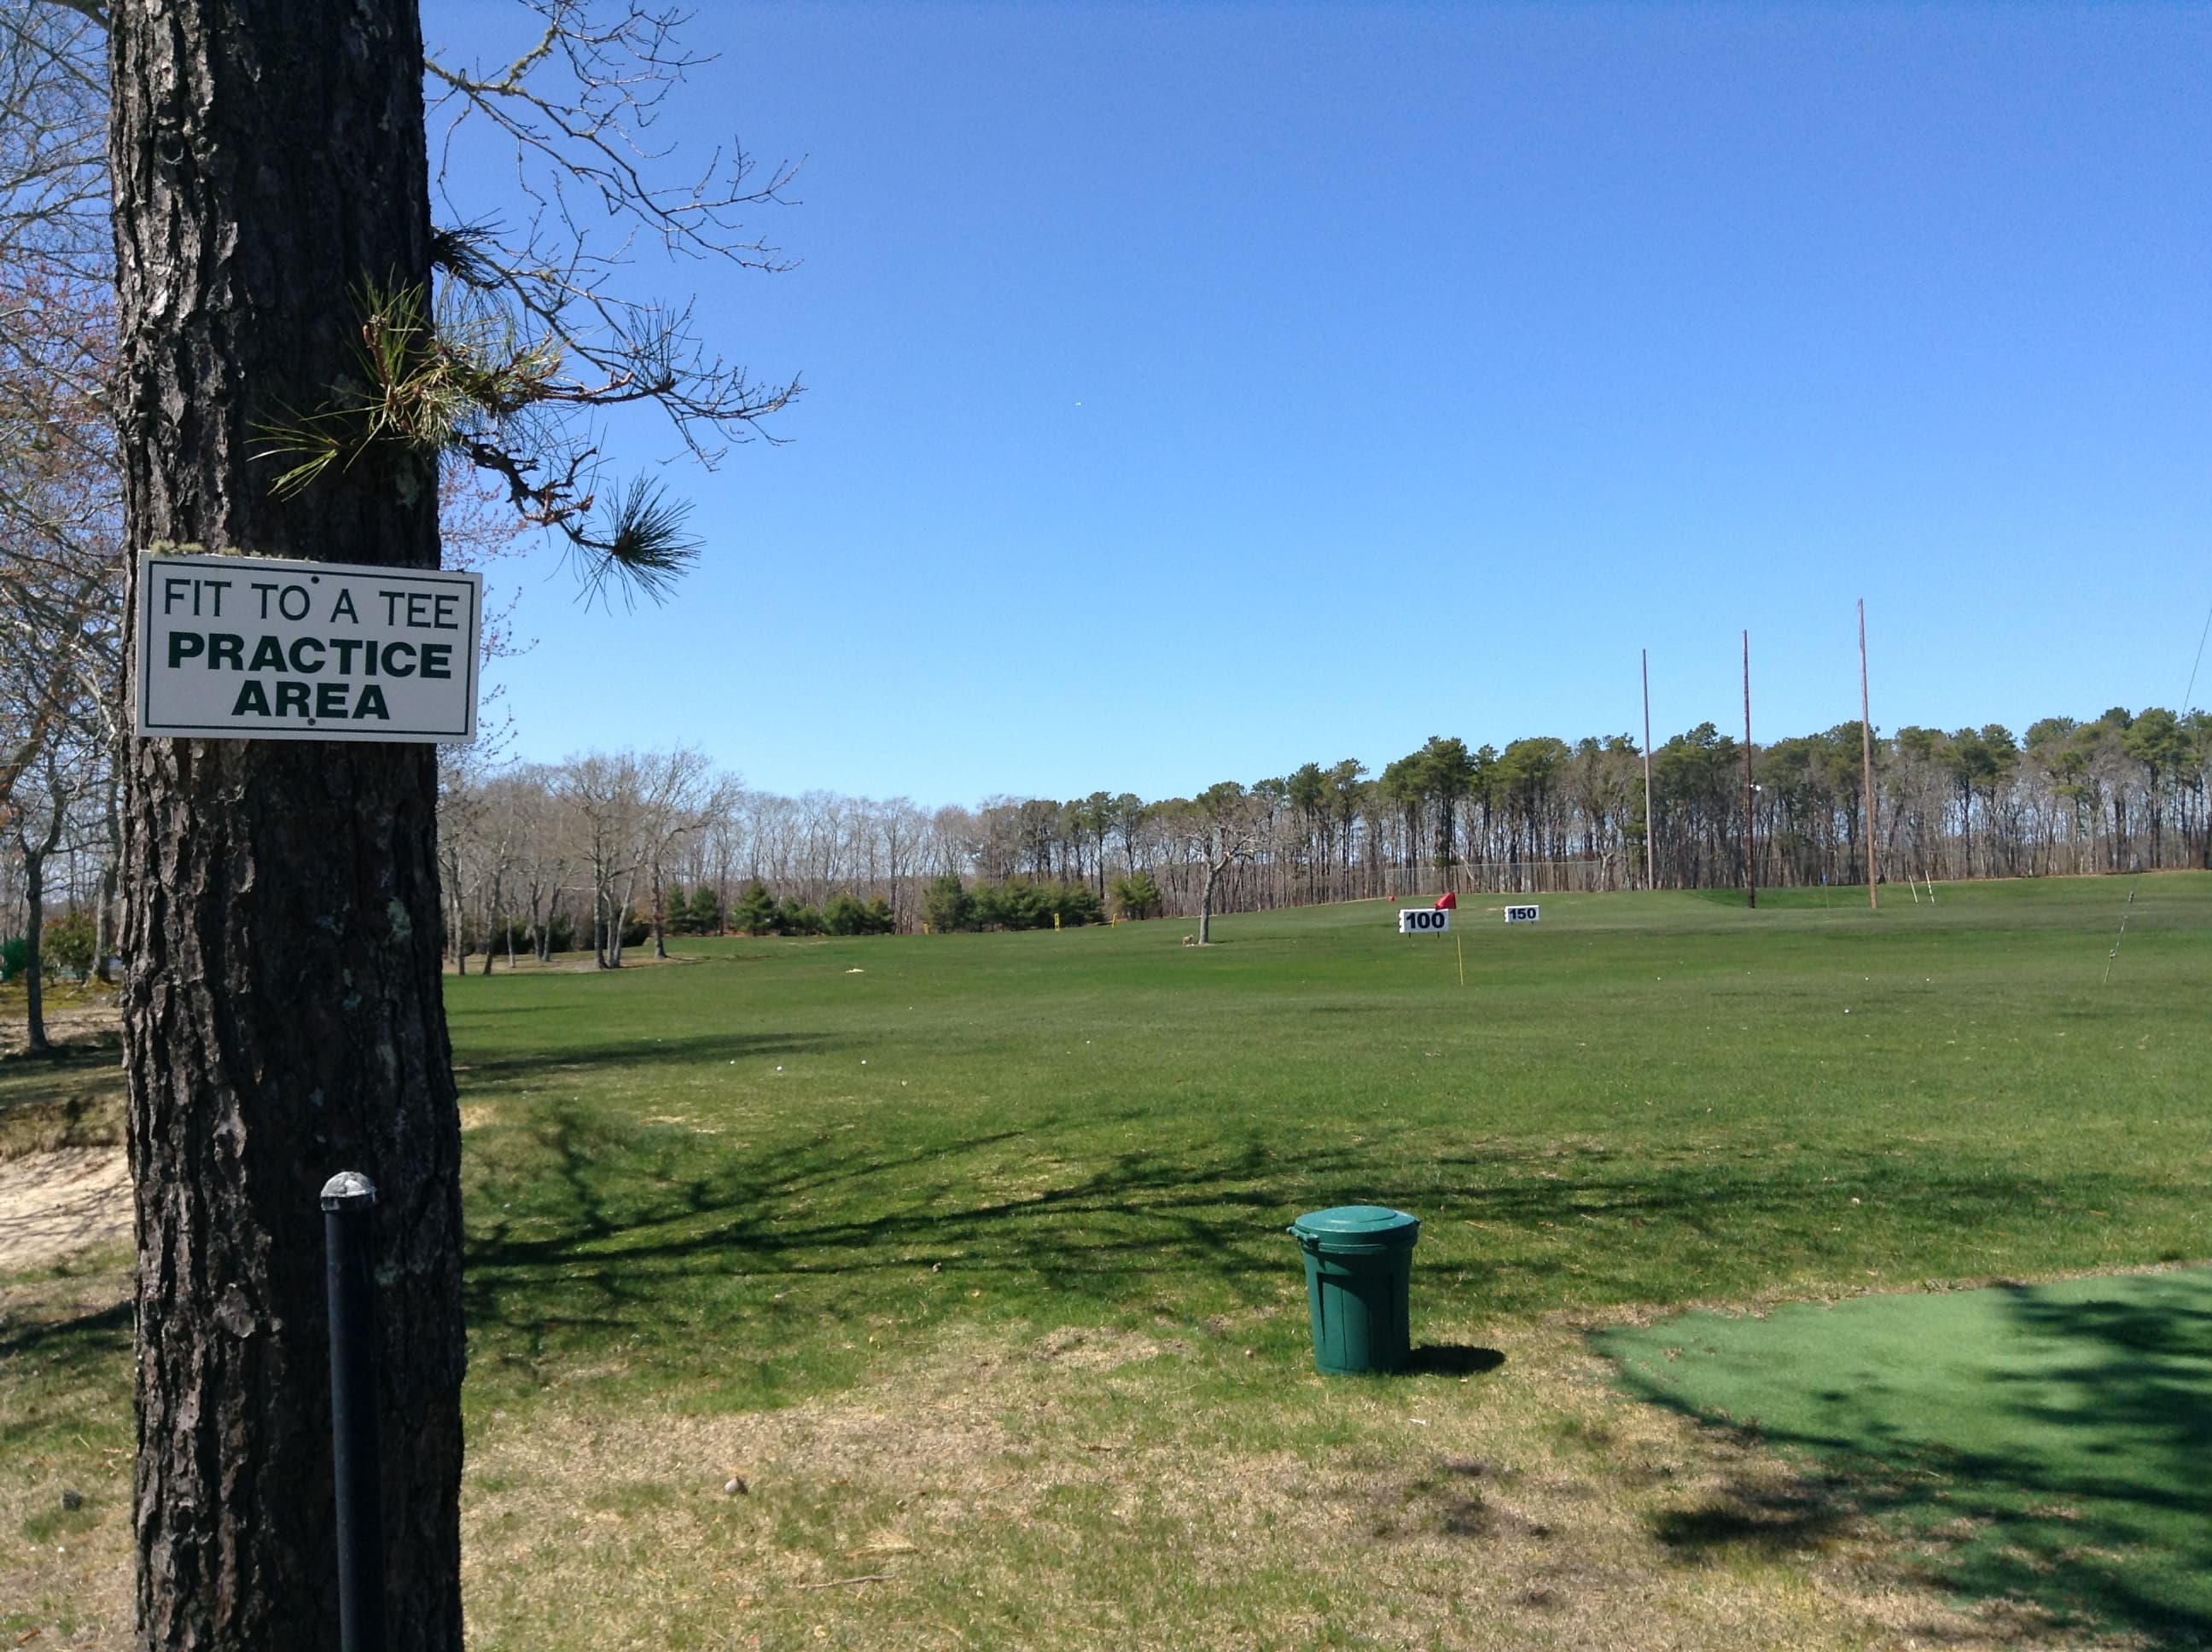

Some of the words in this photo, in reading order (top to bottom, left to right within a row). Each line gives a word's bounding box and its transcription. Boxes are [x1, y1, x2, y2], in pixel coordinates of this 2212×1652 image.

[164, 578, 232, 617] FIT
[250, 583, 311, 621] TO
[329, 589, 359, 624] A
[379, 590, 460, 630] TEE
[167, 631, 453, 679] PRACTICE
[230, 680, 390, 720] AREA
[1406, 912, 1445, 928] 100
[1510, 908, 1536, 920] 150
